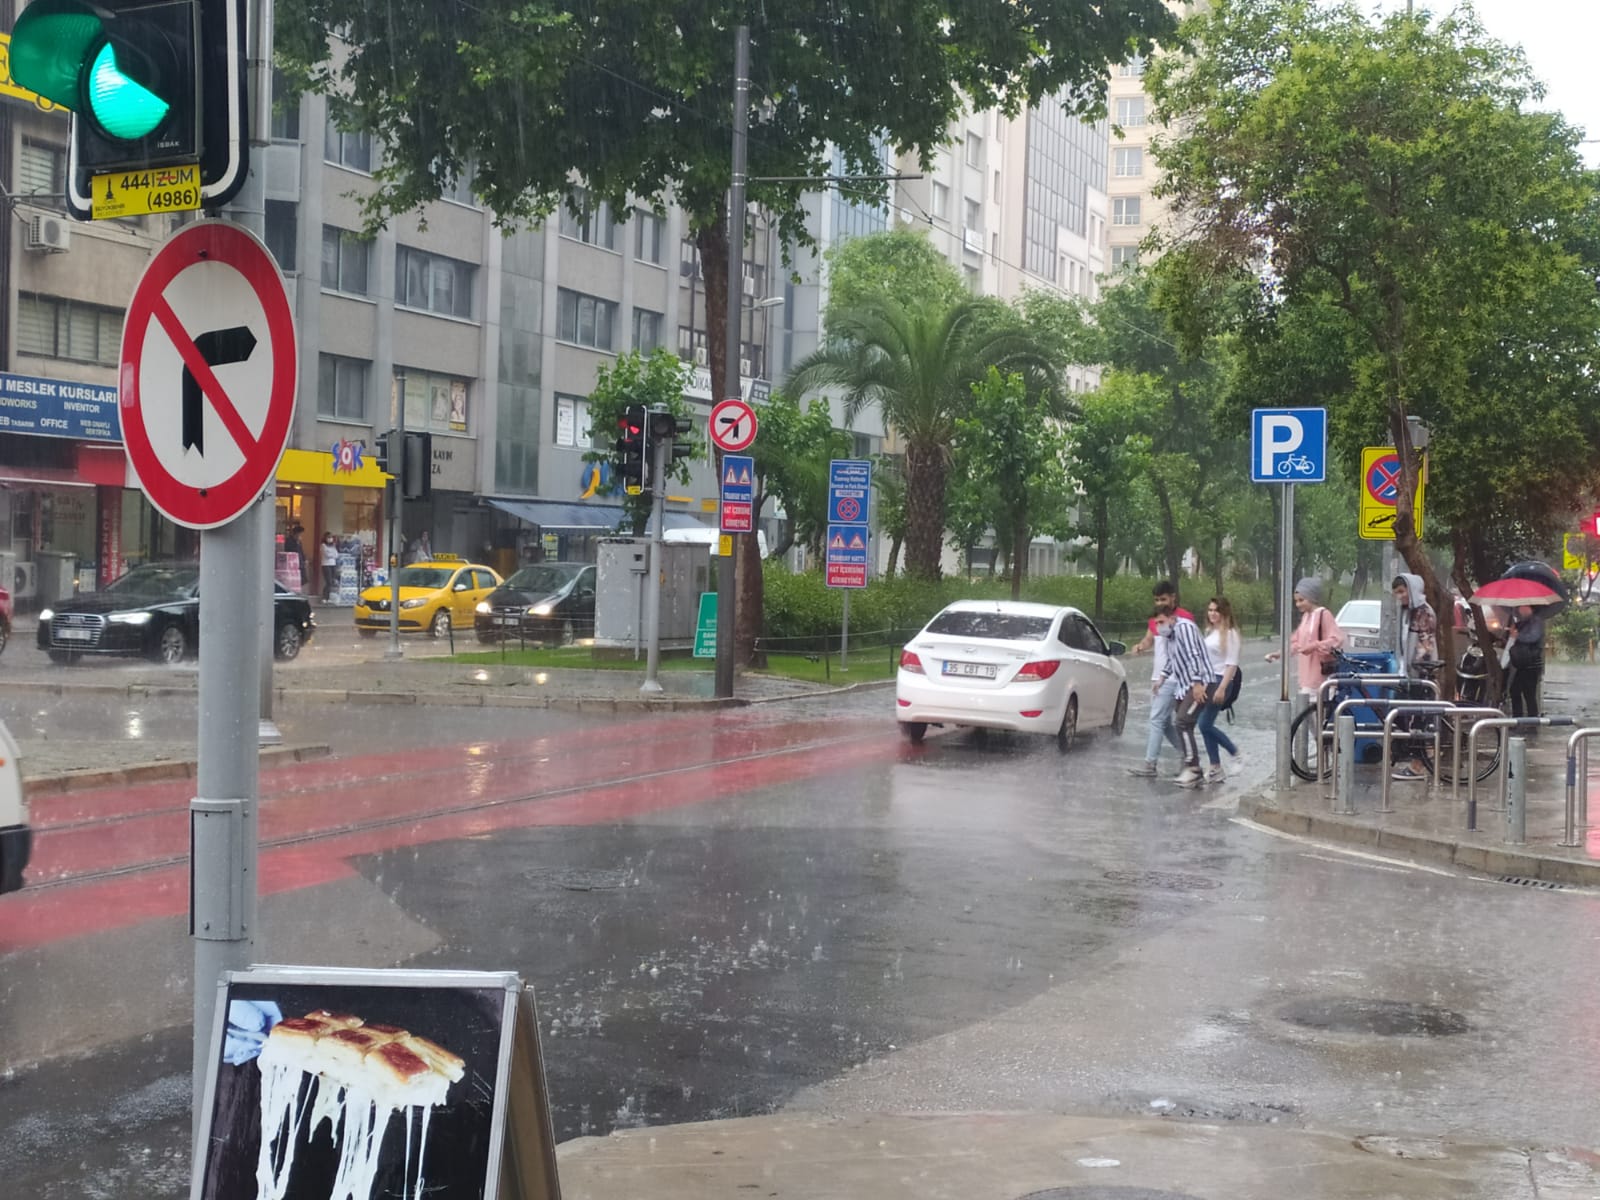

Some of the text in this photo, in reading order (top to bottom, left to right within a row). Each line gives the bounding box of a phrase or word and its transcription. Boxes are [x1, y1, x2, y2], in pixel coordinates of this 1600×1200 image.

[147, 187, 199, 211] (4986)
[6, 379, 57, 397] MESLEK
[58, 385, 117, 404] KURSLARI
[63, 401, 101, 414] INVENTOR
[40, 417, 69, 430] OFFICE
[1261, 415, 1304, 476] P
